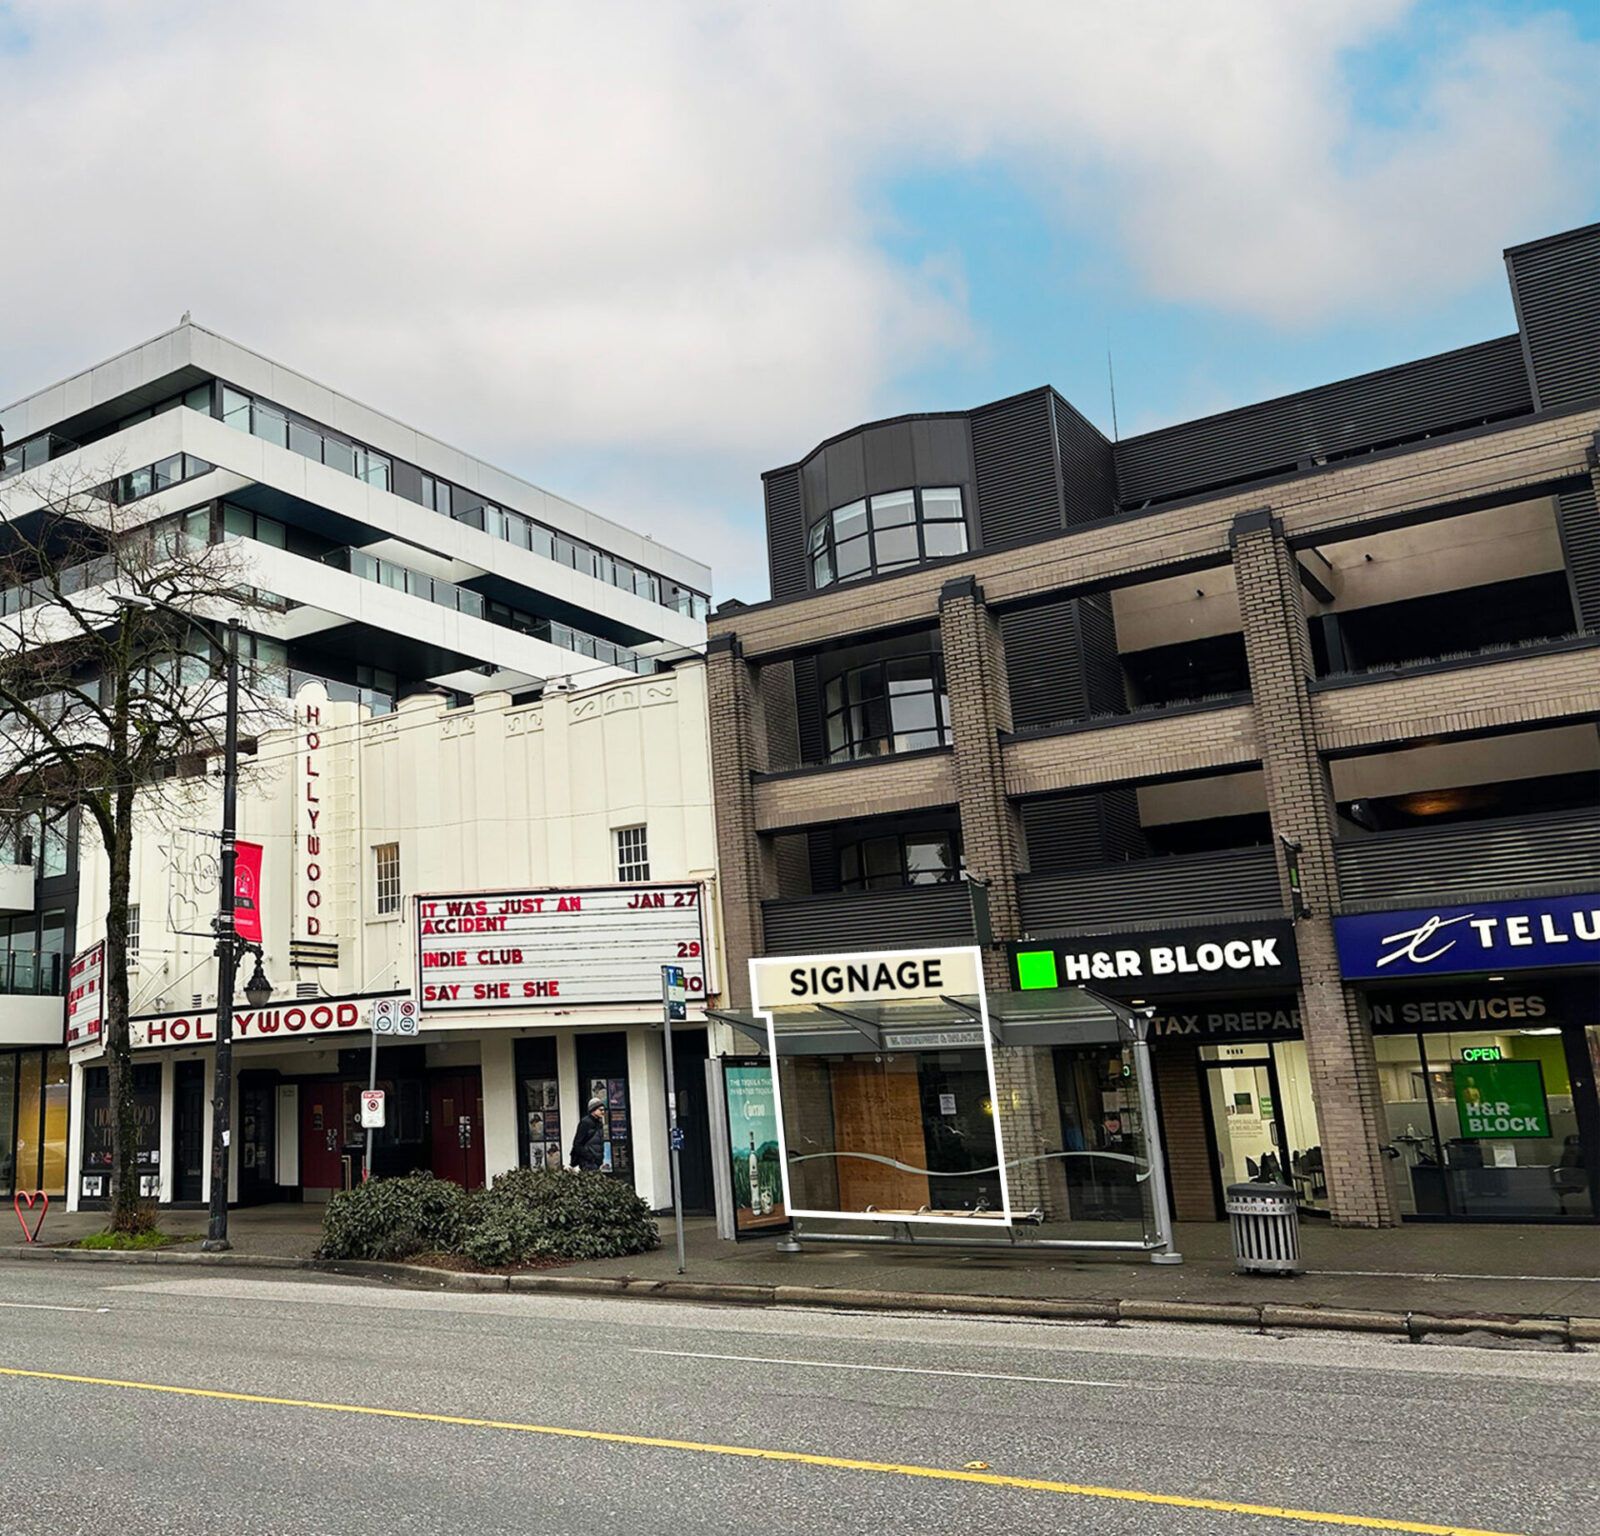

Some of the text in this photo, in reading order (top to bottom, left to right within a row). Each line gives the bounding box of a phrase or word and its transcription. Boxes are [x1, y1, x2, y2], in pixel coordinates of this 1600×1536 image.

[306, 705, 321, 936] HOLLYWOOD
[422, 891, 697, 918] IT WAS JUST AN JAN 27
[422, 916, 507, 935] ACCIDENT
[423, 942, 701, 968] INDIE CLUB 29
[1065, 938, 1281, 981] H&R BLOCK
[424, 984, 460, 1001] SAY
[473, 982, 511, 999] SHE
[522, 980, 560, 997] SHE
[147, 1003, 358, 1044] HOLYWOOD
[1152, 1014, 1201, 1035] TAX
[1402, 996, 1546, 1023] SERVICES
[1463, 1048, 1500, 1061] OPEN
[1466, 1101, 1511, 1116] H&R
[1469, 1117, 1540, 1132] BLOCK
